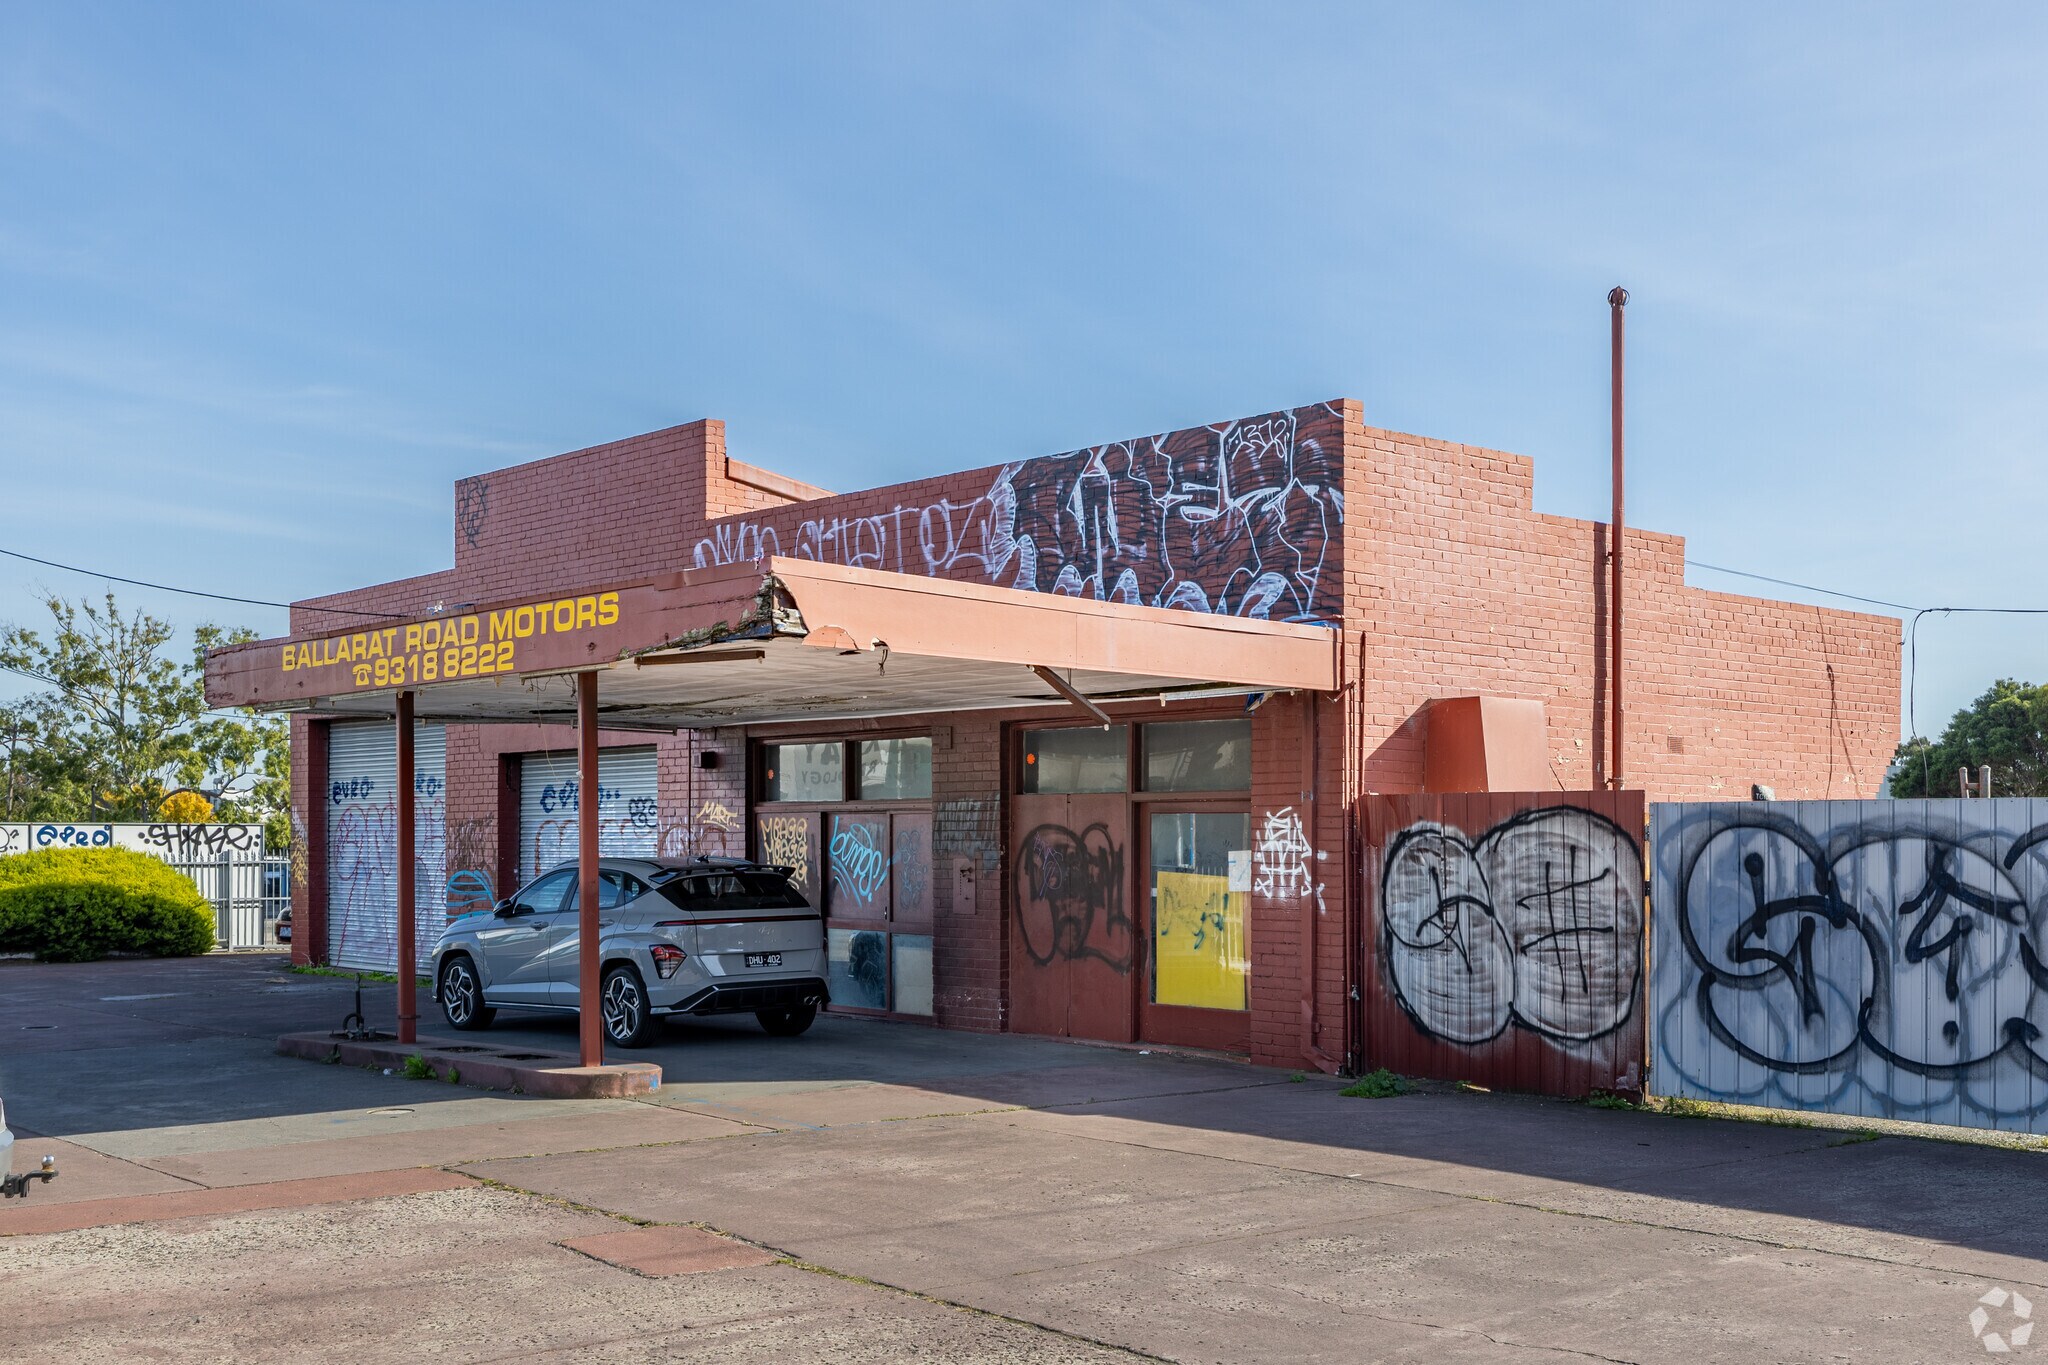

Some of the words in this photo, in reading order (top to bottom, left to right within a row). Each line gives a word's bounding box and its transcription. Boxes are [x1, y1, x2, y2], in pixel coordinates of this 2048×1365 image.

[282, 629, 397, 672] BALLARAT
[405, 616, 479, 653] ROAD
[489, 592, 619, 641] MOTORS
[374, 651, 438, 686] 9318
[444, 641, 514, 678] 8222
